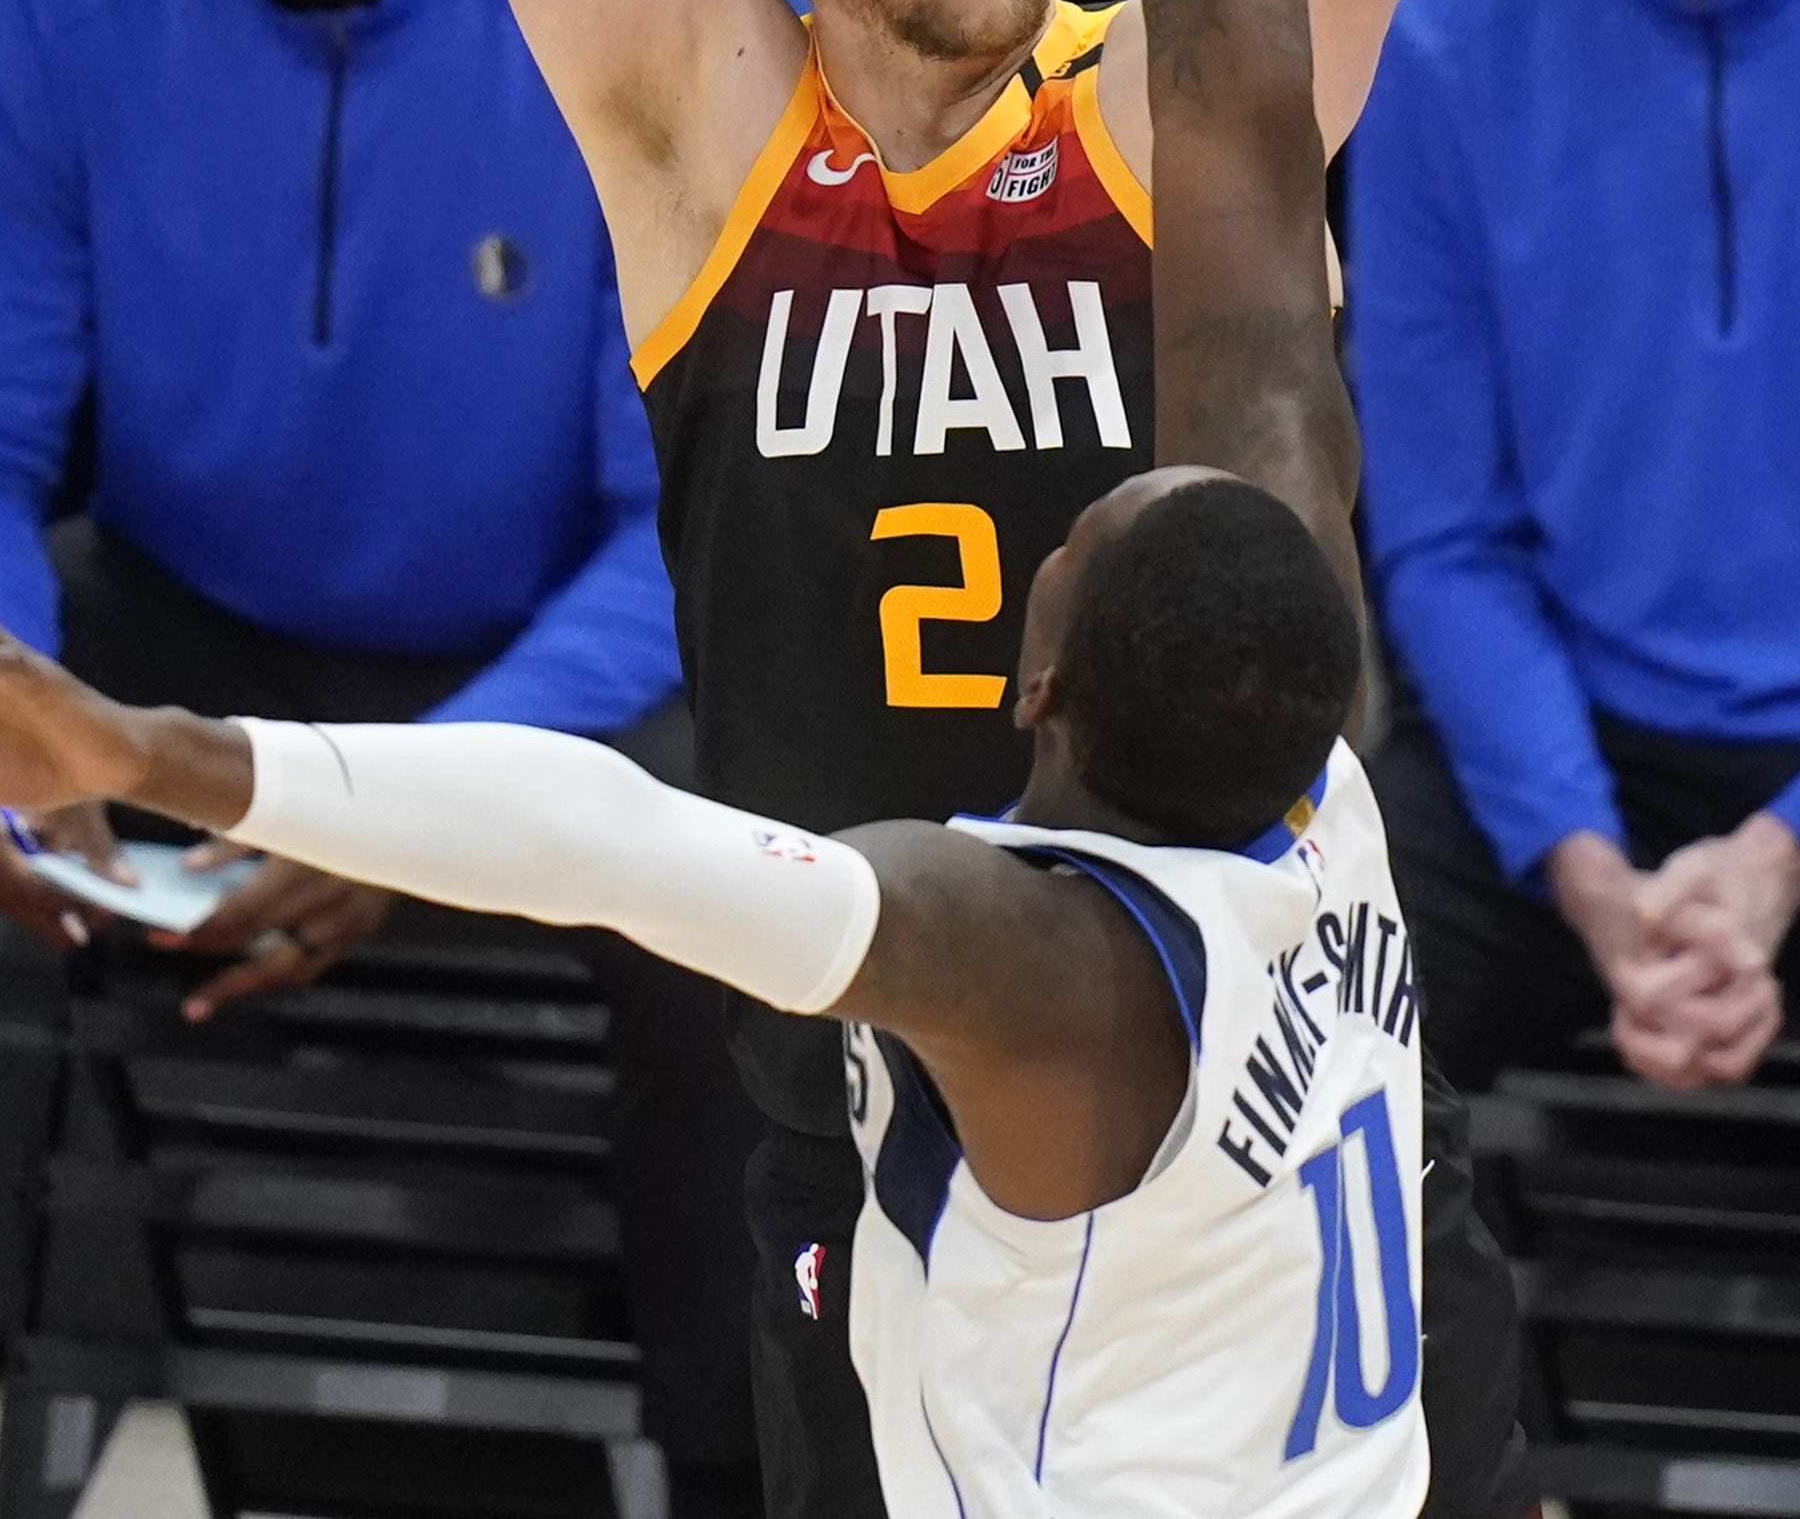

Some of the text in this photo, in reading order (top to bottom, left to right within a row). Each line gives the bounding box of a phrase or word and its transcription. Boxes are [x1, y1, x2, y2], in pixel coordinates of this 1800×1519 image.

[1007, 161, 1056, 198] FIGHT
[1014, 156, 1037, 170] FOR
[756, 281, 1132, 458] UTAH
[870, 502, 1008, 709] 2
[1283, 1086, 1417, 1462] 10
